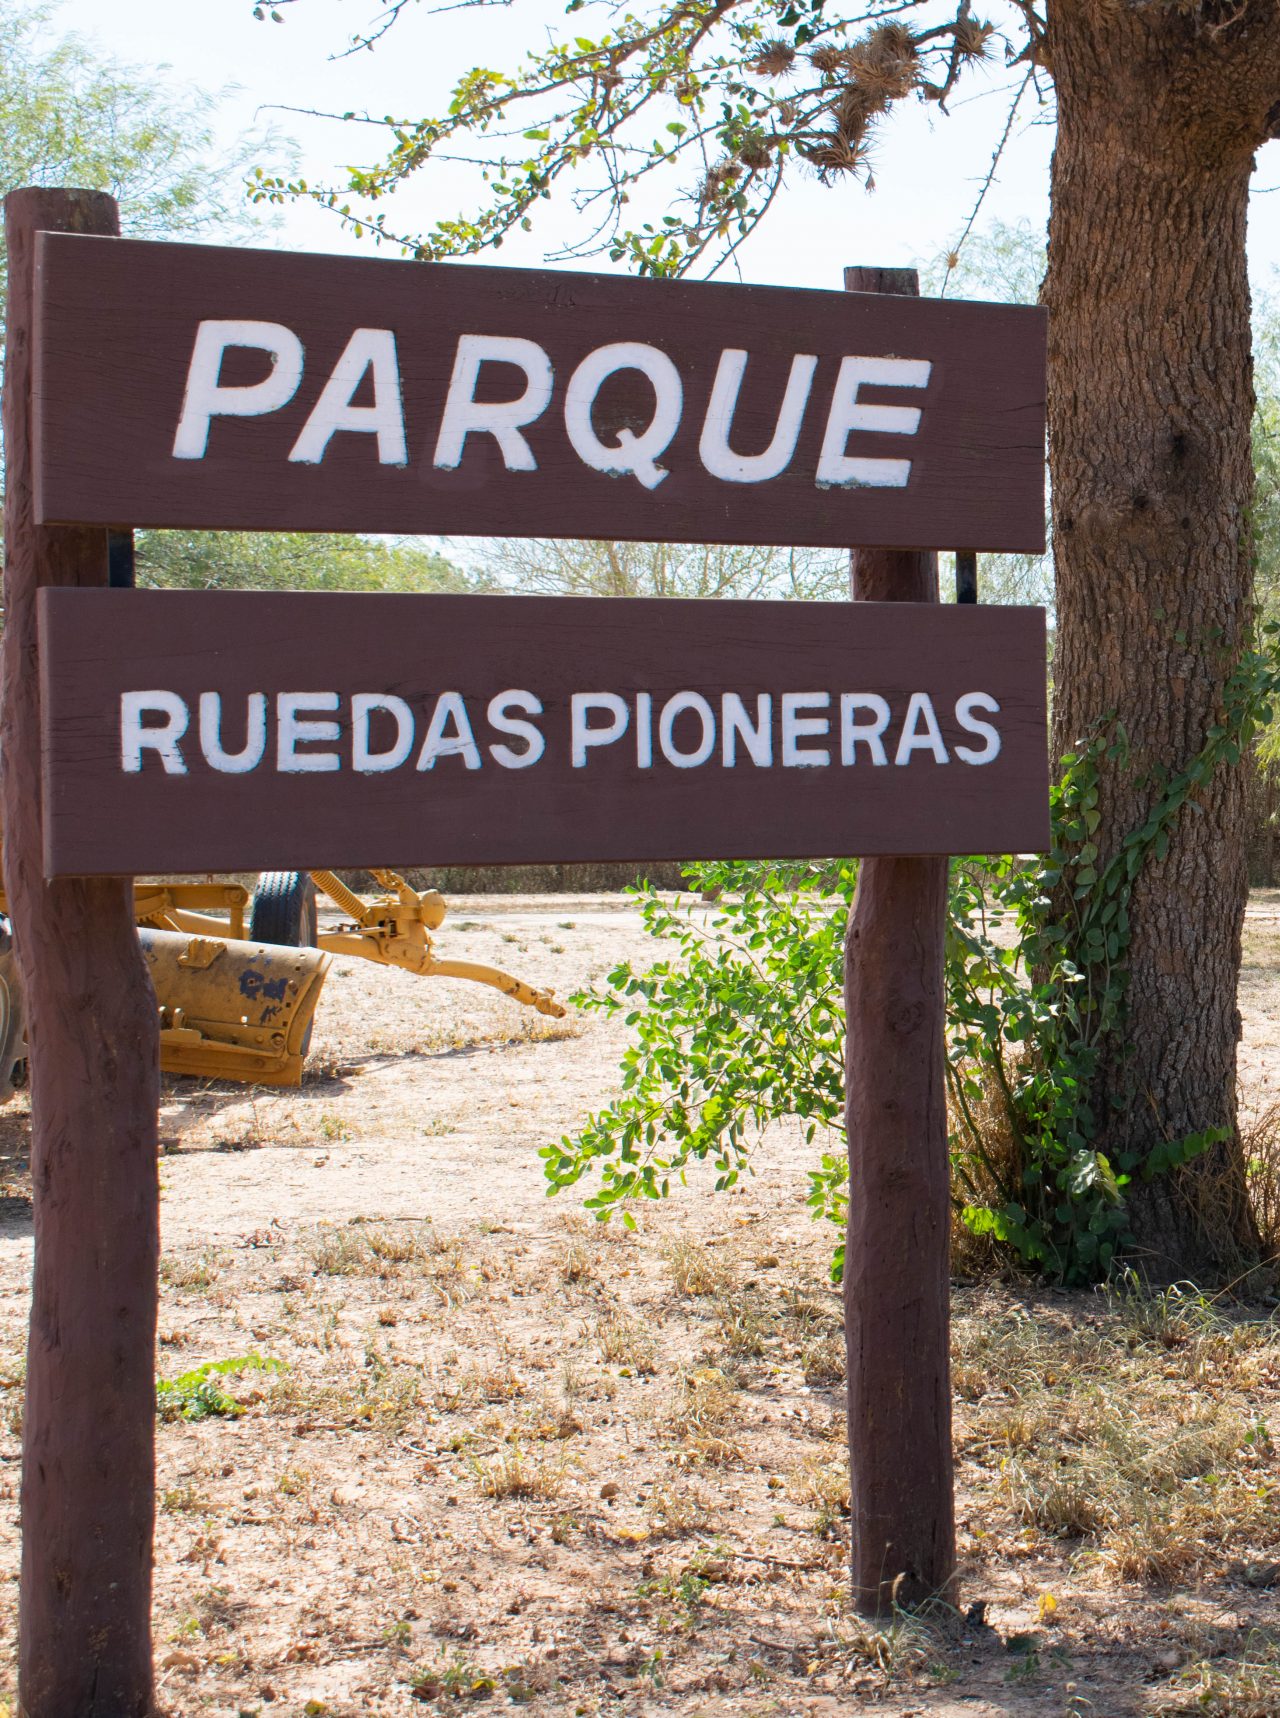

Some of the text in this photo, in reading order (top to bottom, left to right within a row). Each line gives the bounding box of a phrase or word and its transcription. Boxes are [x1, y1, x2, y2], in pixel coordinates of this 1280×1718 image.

[172, 319, 933, 491] PARQUE
[120, 689, 1002, 774] RUEDAS PIONERAS
